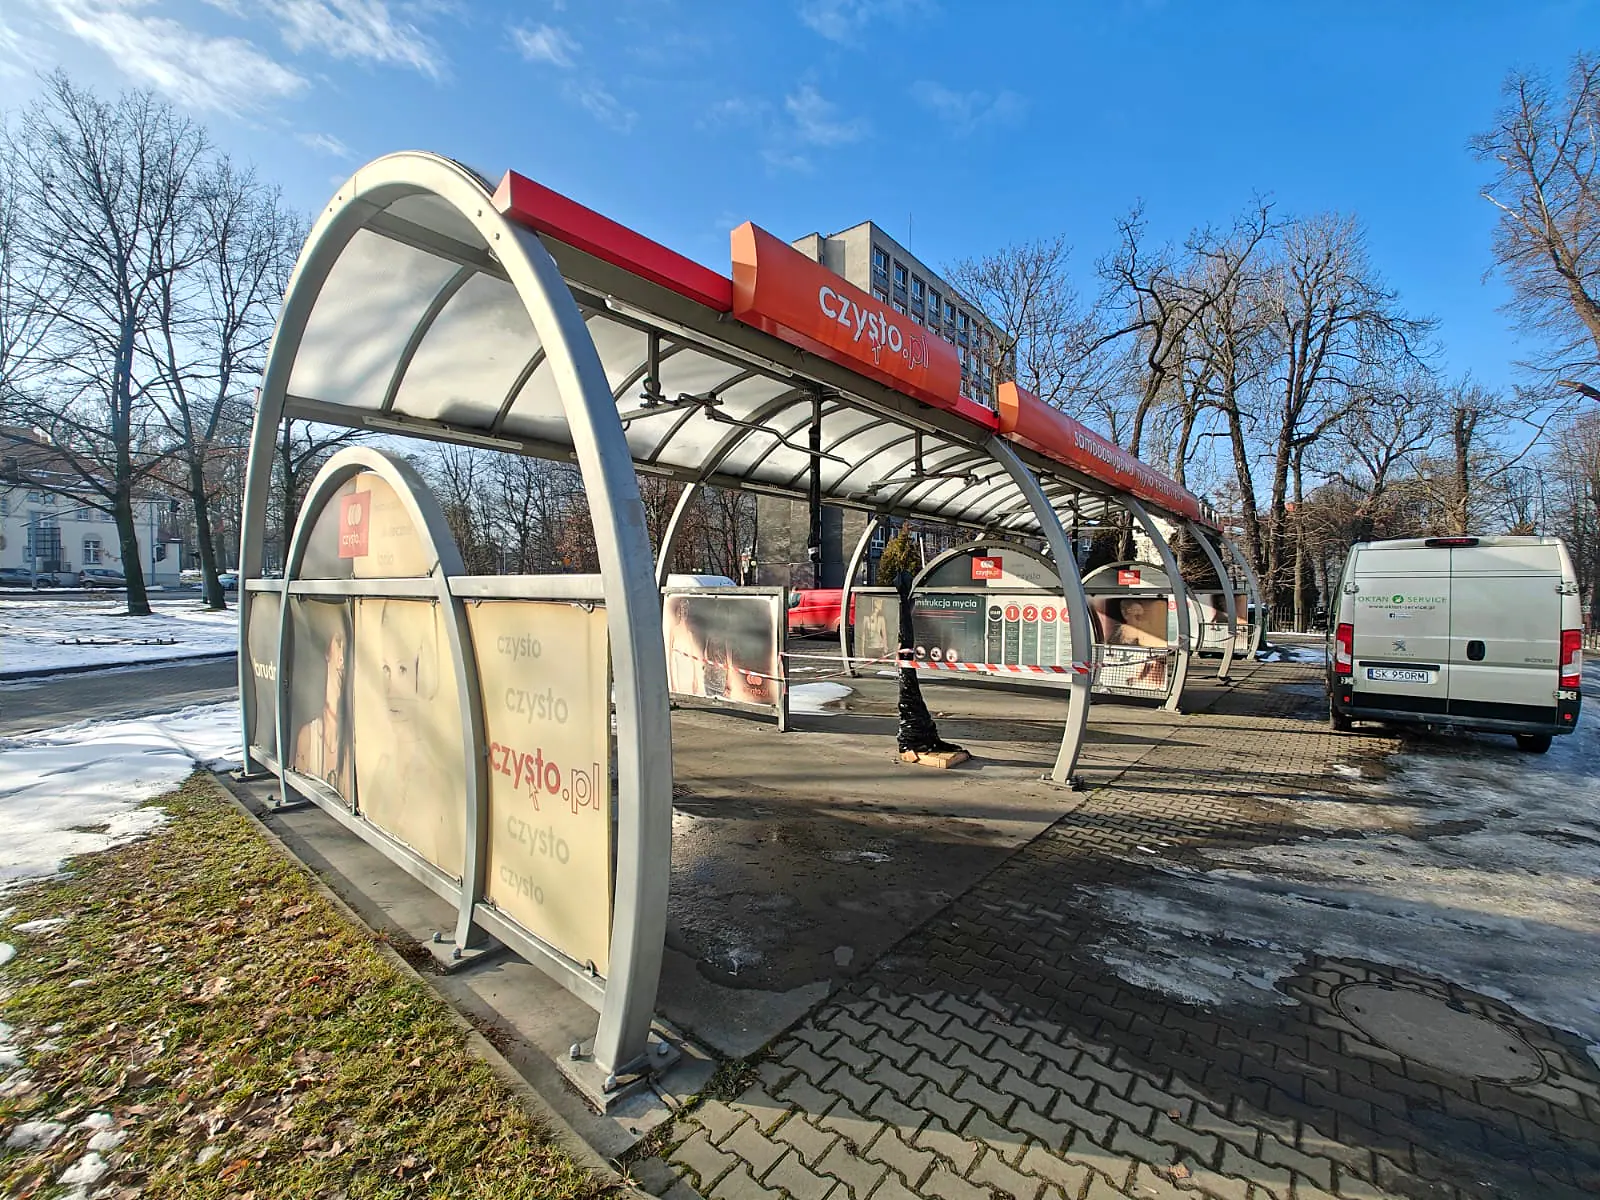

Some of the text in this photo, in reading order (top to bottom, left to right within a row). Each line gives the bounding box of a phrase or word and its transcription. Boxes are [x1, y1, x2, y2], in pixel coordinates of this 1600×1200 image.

[819, 286, 929, 370] czysto.pl
[914, 598, 977, 610] instrukcja mycia
[1358, 595, 1389, 603] OKTAN
[1027, 609, 1034, 619] 2
[1046, 610, 1053, 619] 3
[497, 633, 542, 662] czysto
[1375, 670, 1425, 681] SK 950RM
[505, 687, 569, 725] czysto
[488, 742, 600, 814] czysto.pl
[507, 813, 570, 865] czysto
[500, 862, 544, 905] czysto
